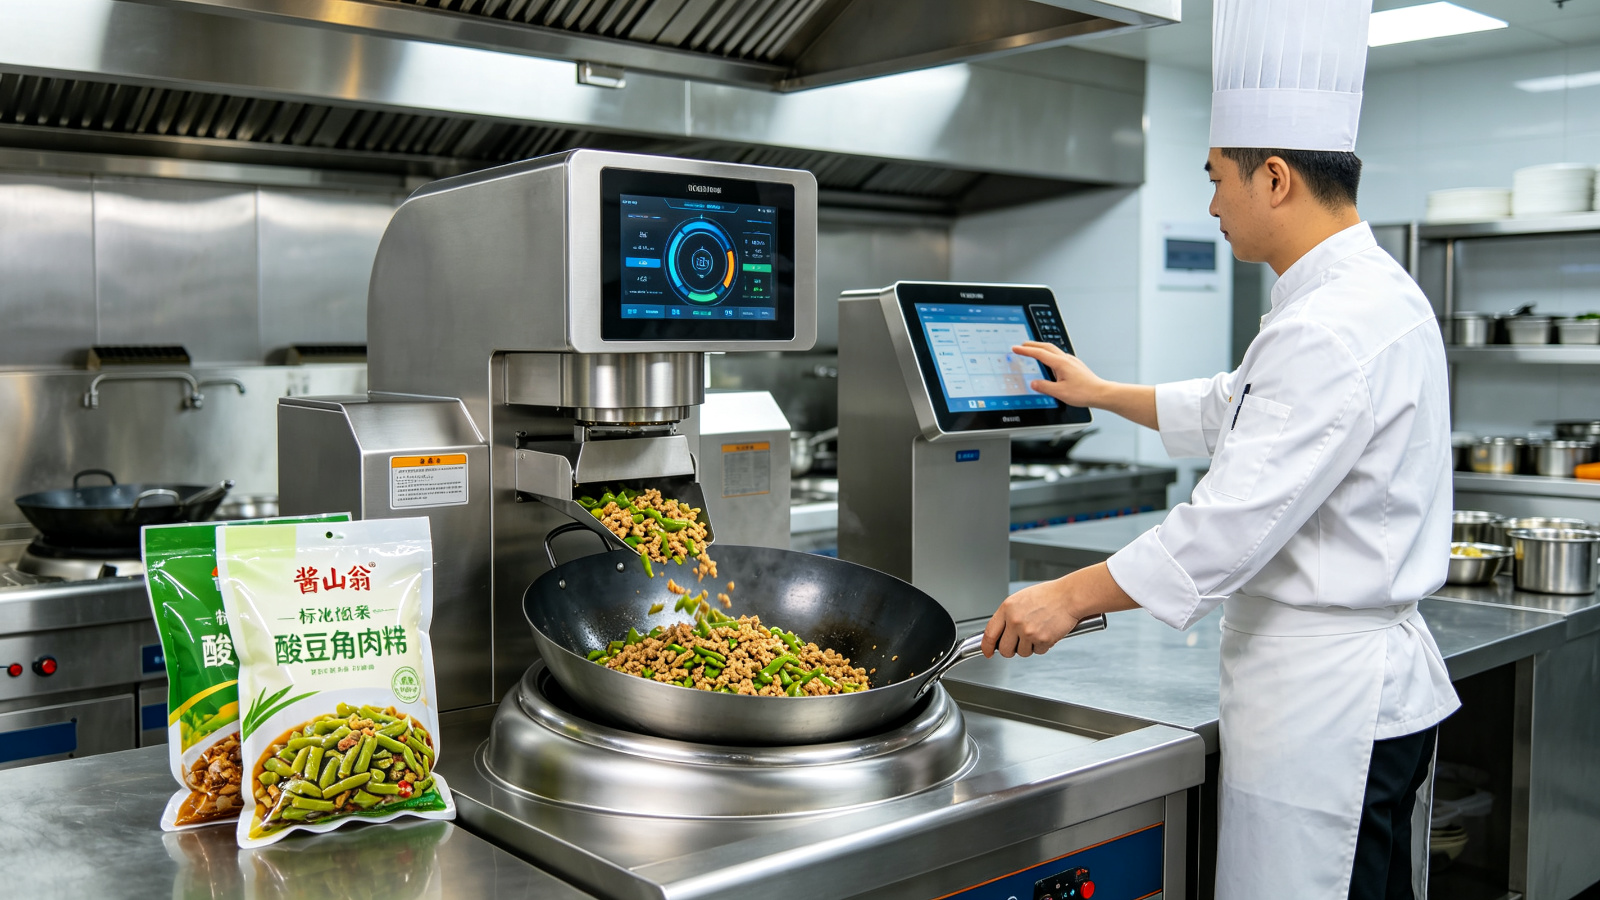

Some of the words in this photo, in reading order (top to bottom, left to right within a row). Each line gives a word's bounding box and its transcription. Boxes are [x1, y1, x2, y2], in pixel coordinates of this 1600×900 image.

[294, 565, 371, 594] 酱山翁
[201, 632, 234, 668] 酸
